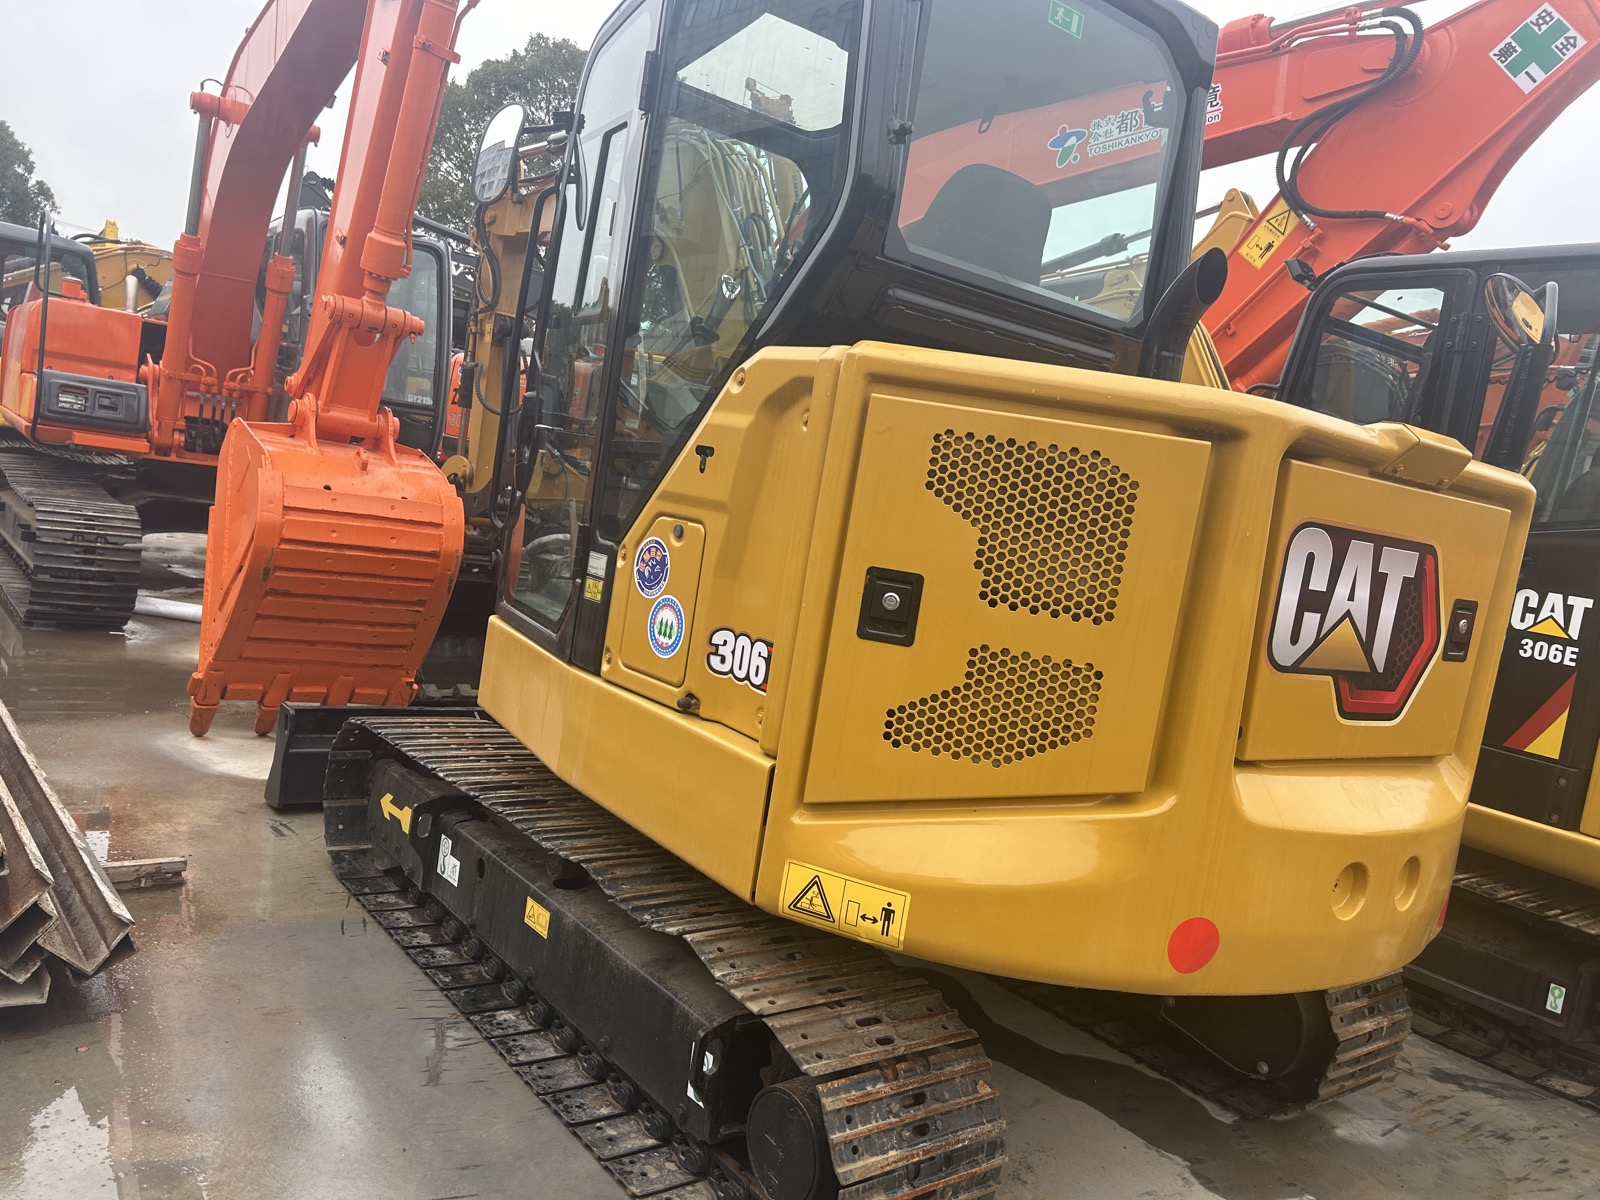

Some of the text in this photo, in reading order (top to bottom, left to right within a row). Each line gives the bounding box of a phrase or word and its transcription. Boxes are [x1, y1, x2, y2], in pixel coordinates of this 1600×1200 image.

[1088, 129, 1159, 156] TOSHIKANKYO
[1272, 527, 1419, 673] CAT
[1510, 588, 1594, 640] CAT
[708, 629, 769, 686] 306
[1518, 638, 1580, 667] 306E
